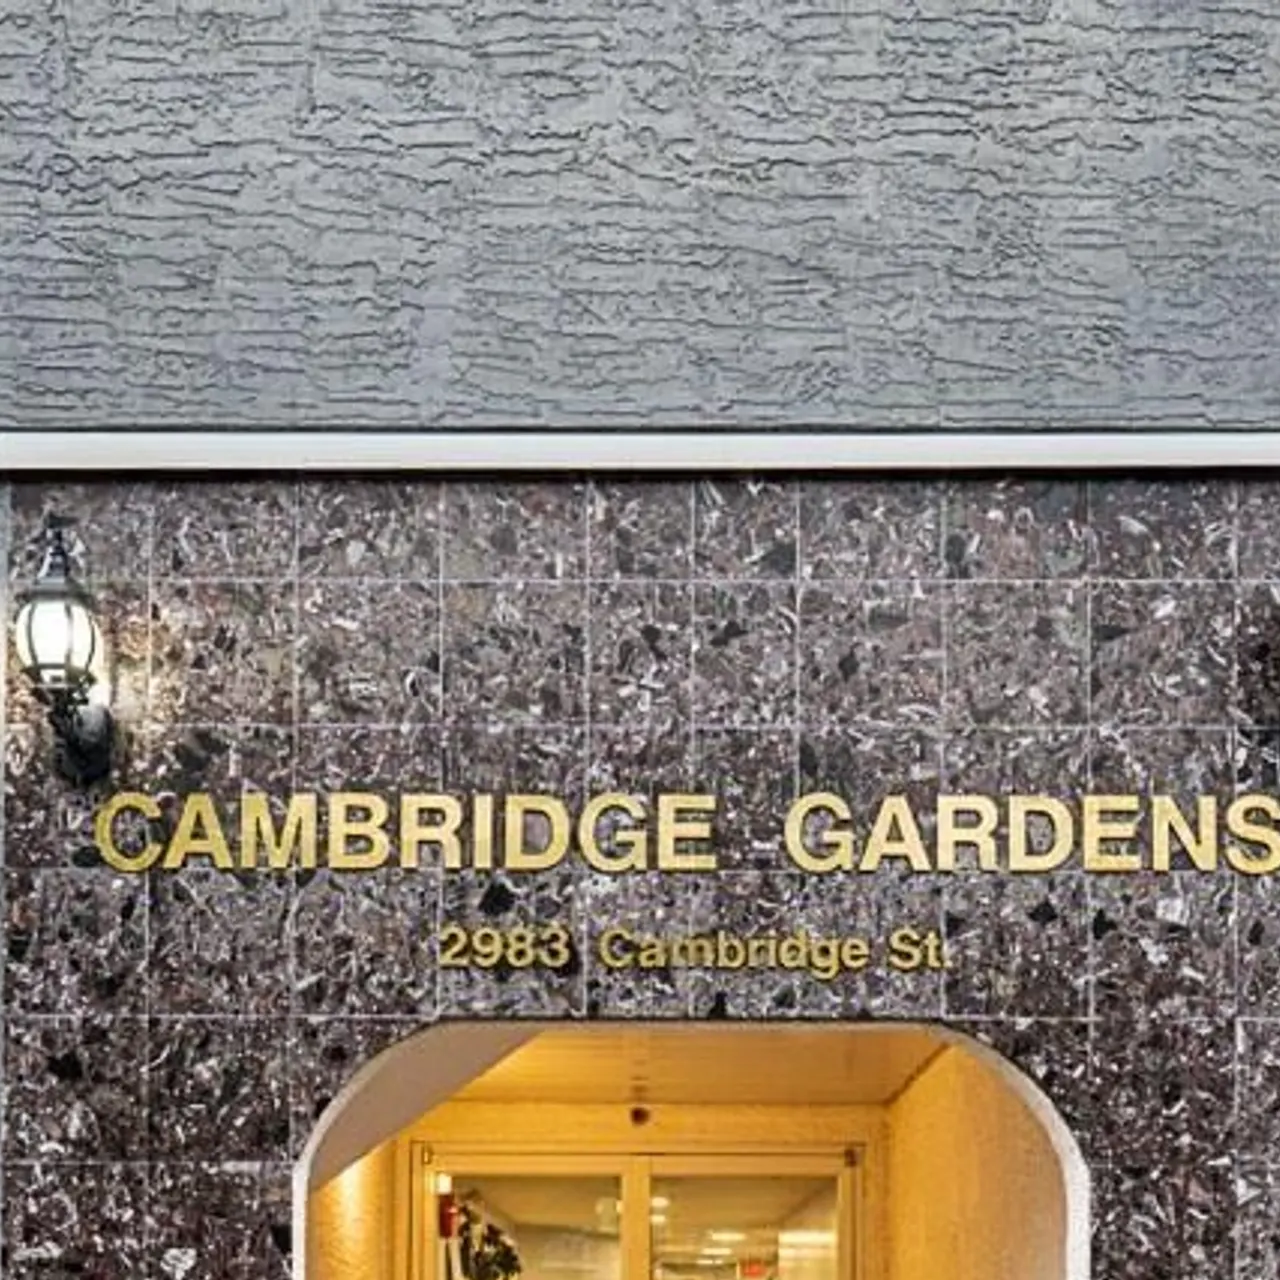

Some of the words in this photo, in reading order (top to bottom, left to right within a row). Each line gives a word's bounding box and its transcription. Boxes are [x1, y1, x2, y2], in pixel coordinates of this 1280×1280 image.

[94, 791, 717, 872] CAMBRIDGE
[438, 926, 572, 969] 2983
[598, 928, 870, 980] Cambridge
[888, 925, 954, 969] St.
